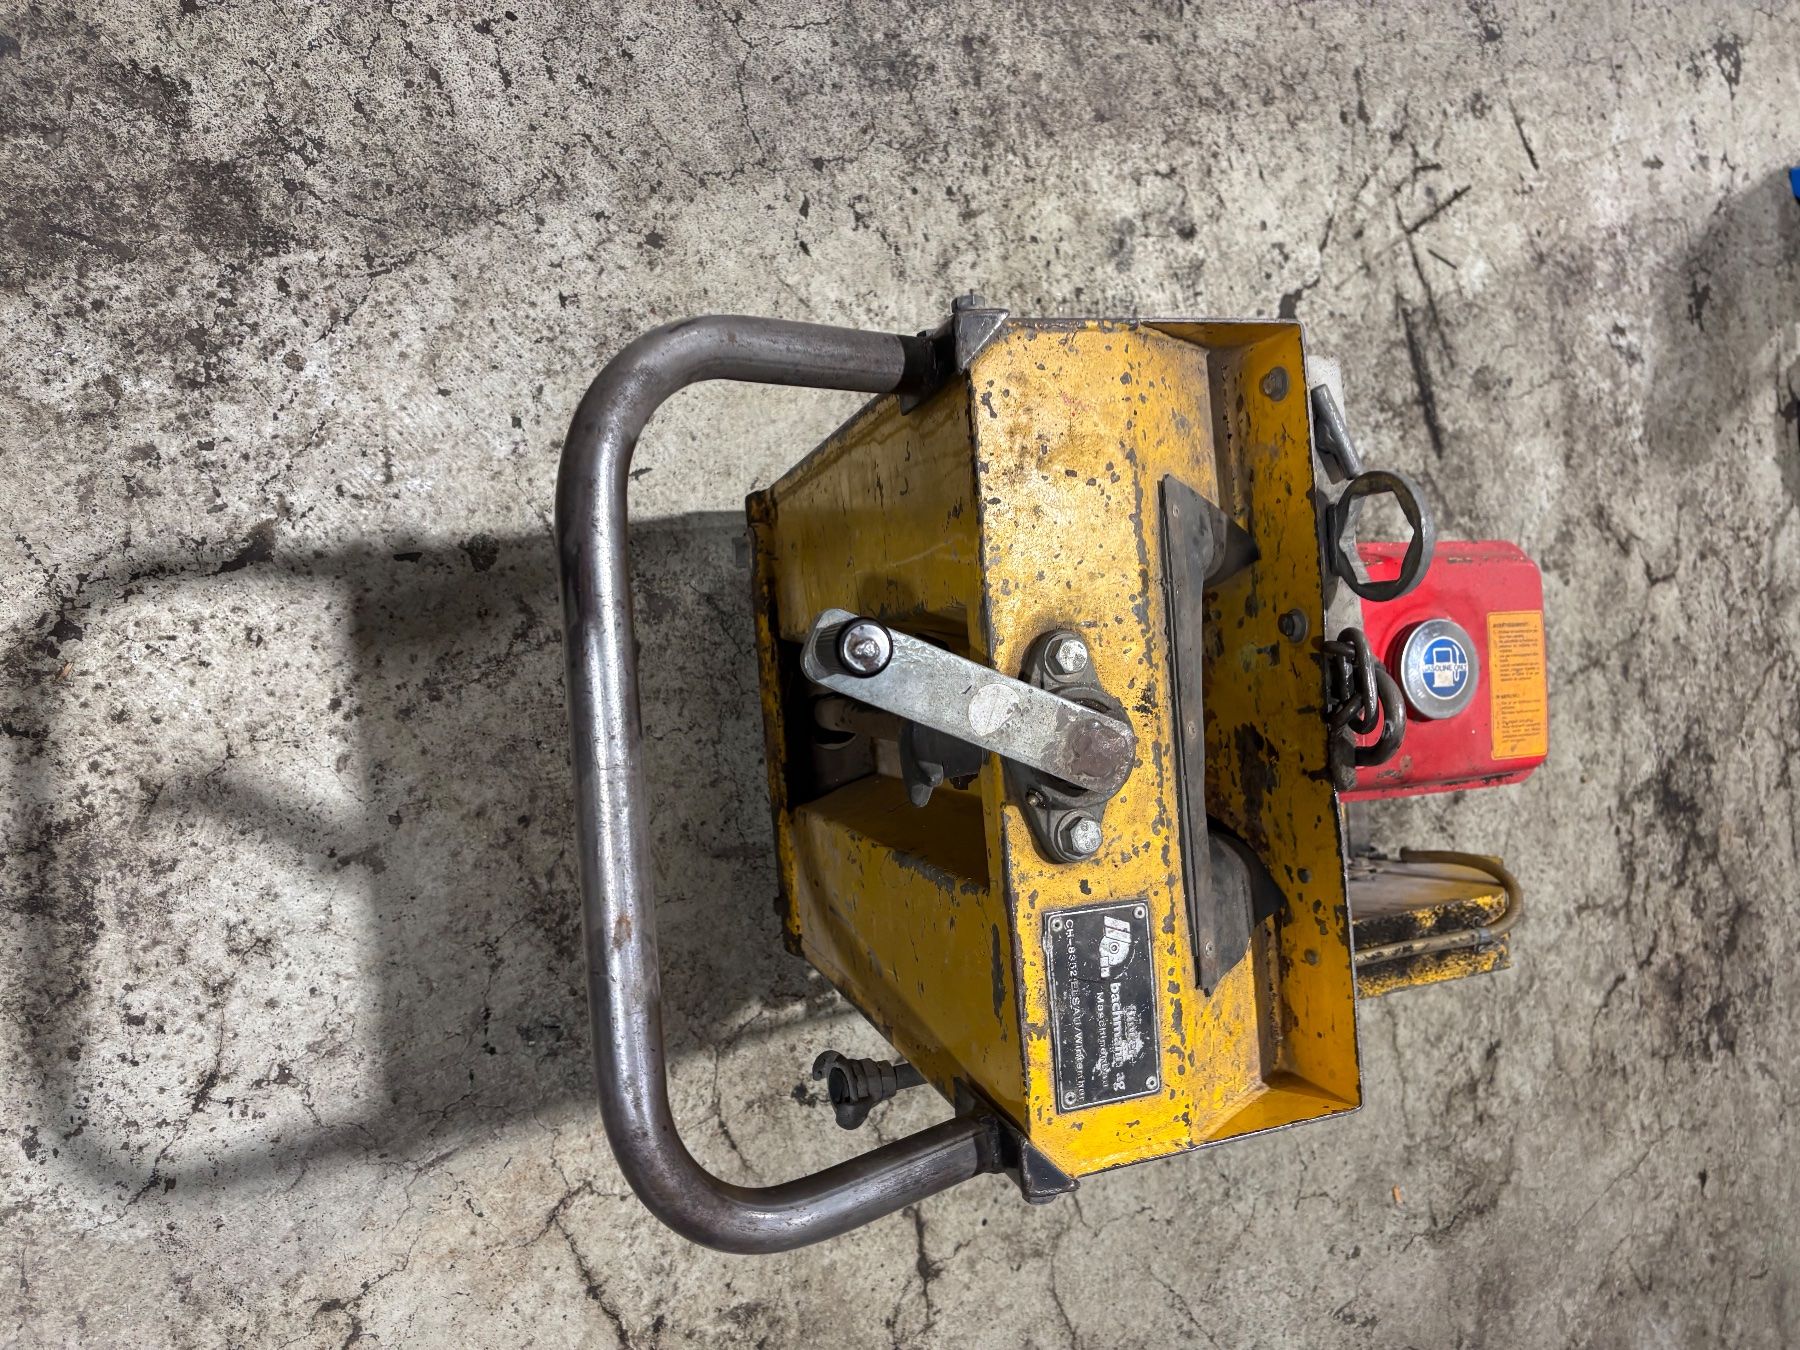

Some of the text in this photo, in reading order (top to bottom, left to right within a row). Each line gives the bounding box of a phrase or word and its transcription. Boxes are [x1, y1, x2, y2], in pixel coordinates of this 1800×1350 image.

[1064, 919, 1078, 977] CH-8352
[1096, 992, 1109, 1088] Maschinenbau
[1110, 982, 1126, 1091] bachmann ag
